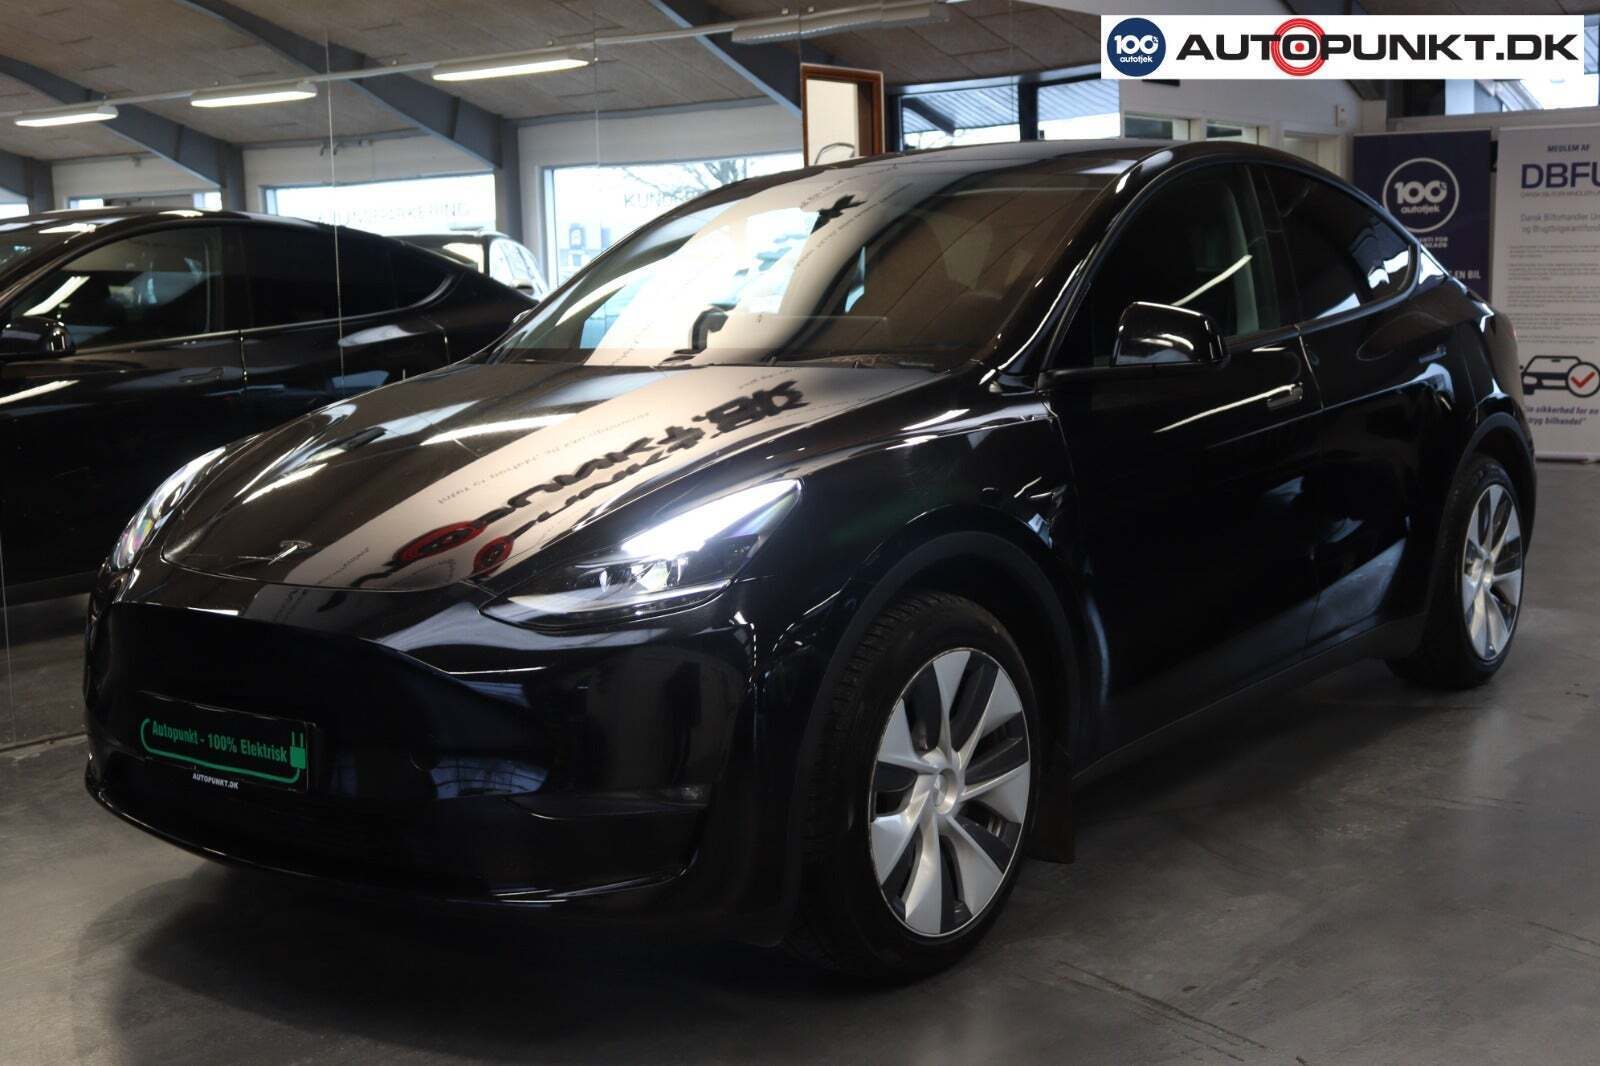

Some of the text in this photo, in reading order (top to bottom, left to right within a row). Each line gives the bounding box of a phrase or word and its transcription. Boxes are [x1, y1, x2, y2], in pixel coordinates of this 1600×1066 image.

[1547, 144, 1590, 153] MEDLEM AF
[1401, 204, 1441, 214] autotjek
[1467, 269, 1481, 280] BIL
[1535, 405, 1575, 414] sikkerhed
[1576, 406, 1587, 414] for
[152, 720, 198, 744] Autopunkt
[207, 733, 238, 753] 100%
[240, 738, 288, 763] Elektrisk
[192, 772, 239, 790] AUTOPUNKT.DK
